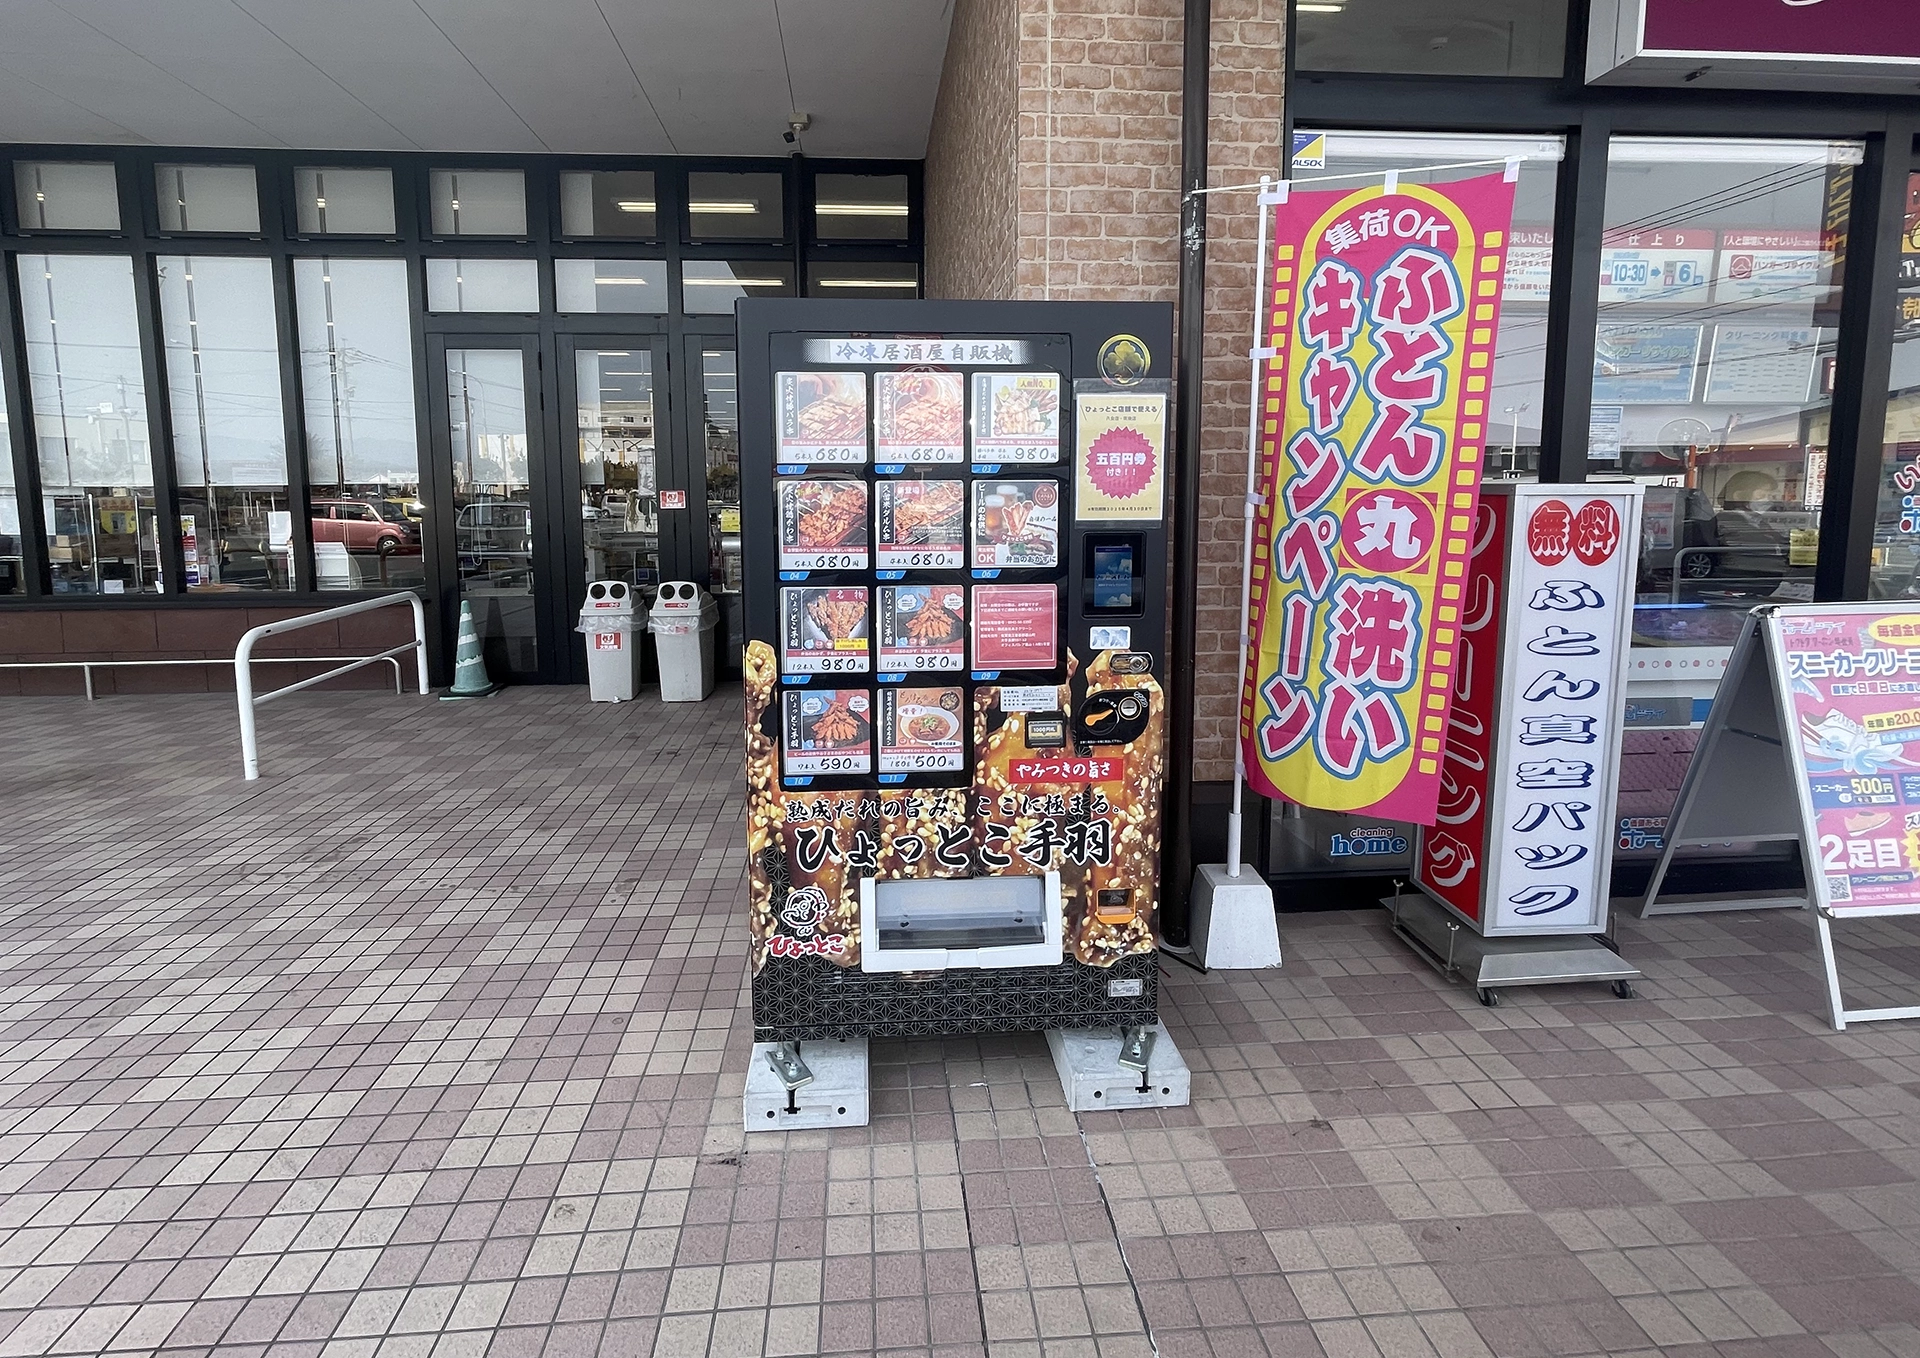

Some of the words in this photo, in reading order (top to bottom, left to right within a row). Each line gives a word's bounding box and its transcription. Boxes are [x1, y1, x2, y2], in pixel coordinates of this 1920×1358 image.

[1291, 159, 1323, 167] ALSOK
[1324, 208, 1451, 255] 集荷OK
[1614, 263, 1646, 282] 10:30
[1678, 264, 1692, 283] 6
[835, 341, 1014, 363] 冷凍居酒屋自販機
[1095, 452, 1147, 466] 五百円券
[787, 465, 798, 474] 01
[885, 465, 896, 473] 02
[982, 465, 992, 473] 03
[882, 484, 892, 541] 久留米ダルム串
[977, 483, 986, 537] ビールのお供に
[1263, 262, 1358, 757] キャンペーン
[1320, 248, 1458, 774] ふとん丸洗い
[1531, 504, 1619, 557] 無料
[977, 553, 996, 564] OK
[1005, 555, 1057, 564] 弁当のおかずに
[789, 571, 800, 579] 04
[885, 571, 896, 579] 05
[789, 591, 799, 647] ひょっとこ手羽
[883, 590, 893, 645] ひょっとこ手羽
[791, 675, 802, 683] 07
[886, 674, 897, 682] 08
[980, 672, 991, 680] 09
[789, 693, 799, 748] ひょっとこ手羽
[1508, 579, 1606, 917] ふとん真空パック
[1015, 760, 1112, 780] やみつきの旨さ
[794, 777, 804, 785] 10
[1850, 777, 1894, 795] 500円
[1350, 827, 1394, 839] cleaning
[793, 818, 1113, 873] ひょっとこ手羽
[1330, 833, 1409, 857] home
[1819, 833, 1902, 870] 2足目
[766, 934, 846, 959] ひょっとこ
